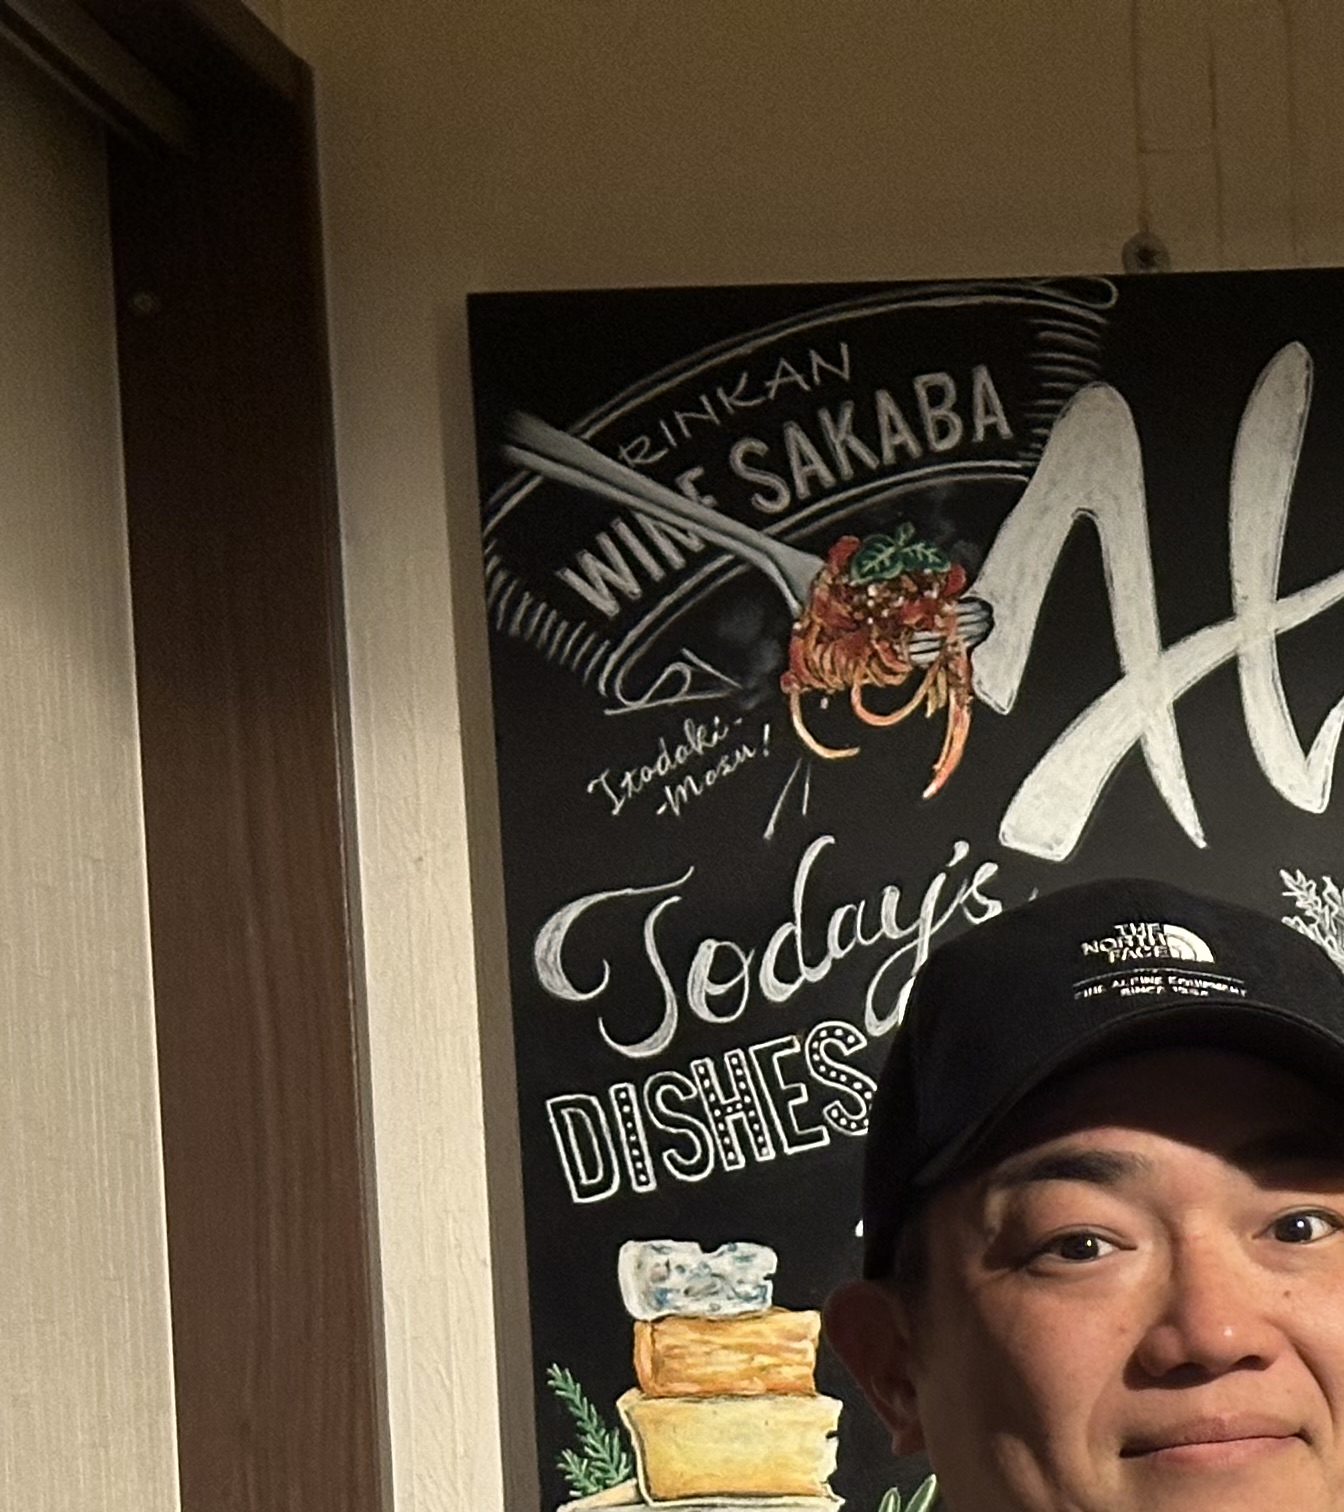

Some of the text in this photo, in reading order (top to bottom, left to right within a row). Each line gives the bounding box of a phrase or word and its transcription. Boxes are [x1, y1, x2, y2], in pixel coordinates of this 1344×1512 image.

[619, 342, 850, 468] RINKAN
[729, 364, 1013, 514] SAKABA
[535, 835, 1003, 1057] Today's
[1080, 933, 1168, 957] NORTH
[1108, 946, 1170, 964] FACE
[1113, 922, 1161, 937] THE
[547, 1020, 879, 1203] DISHES
